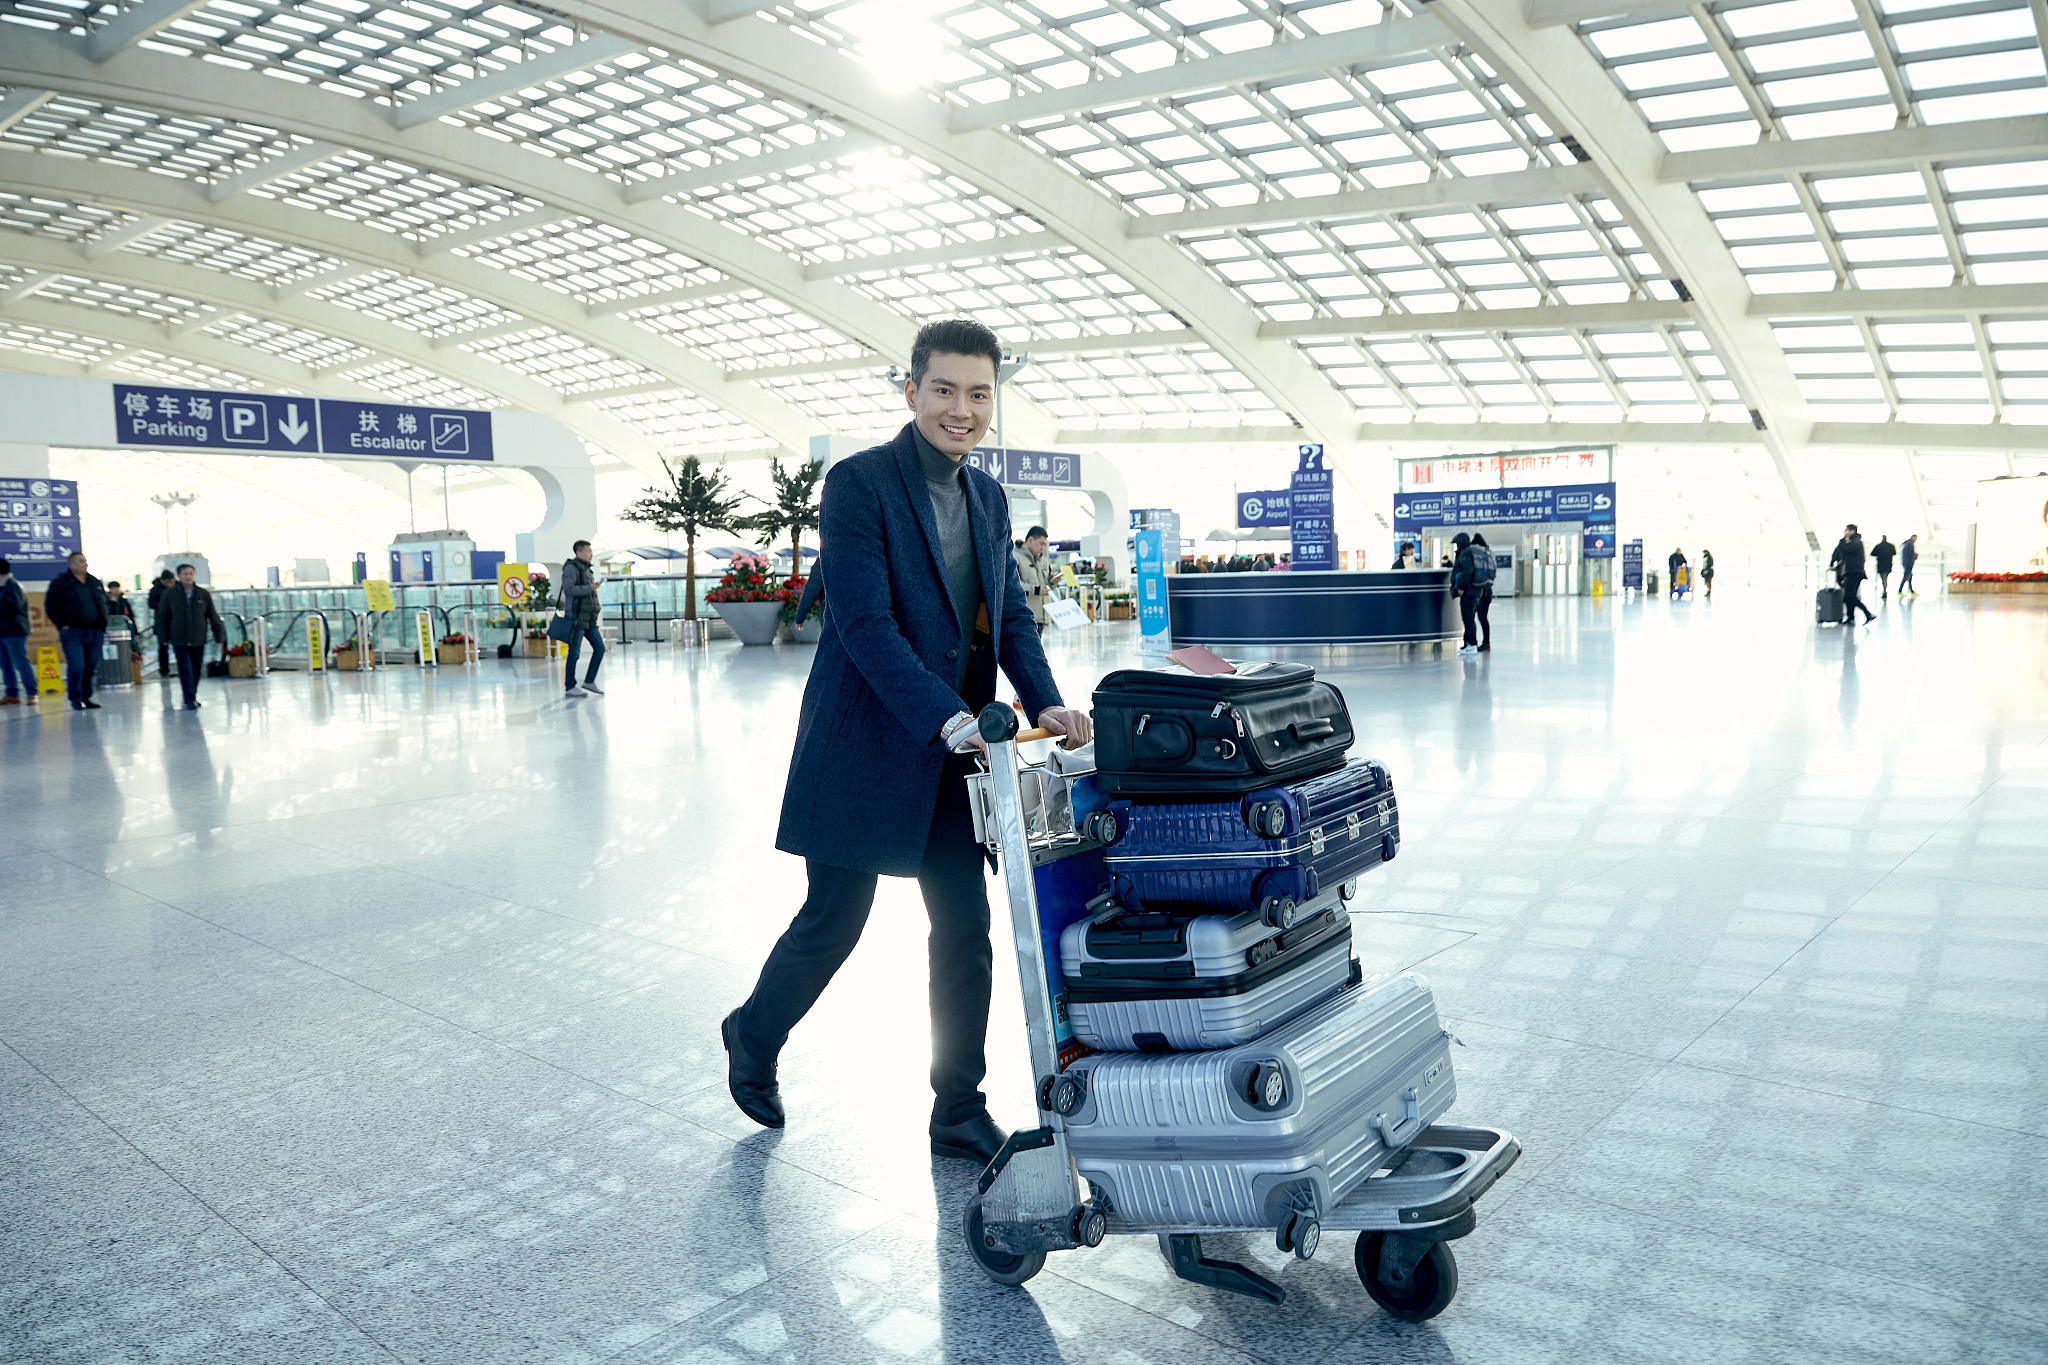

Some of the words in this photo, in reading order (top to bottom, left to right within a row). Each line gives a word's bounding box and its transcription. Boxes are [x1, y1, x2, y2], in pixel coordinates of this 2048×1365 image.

[123, 391, 214, 422] 停车场
[133, 418, 208, 442] Parking
[232, 408, 257, 435] P
[358, 410, 418, 435] 扶梯
[350, 432, 427, 452] Escalator
[1021, 455, 1049, 471] 扶梯
[1018, 470, 1052, 482] Escalator
[1444, 497, 1456, 506] B1
[1266, 510, 1288, 519] Airport
[1444, 512, 1456, 521] B2
